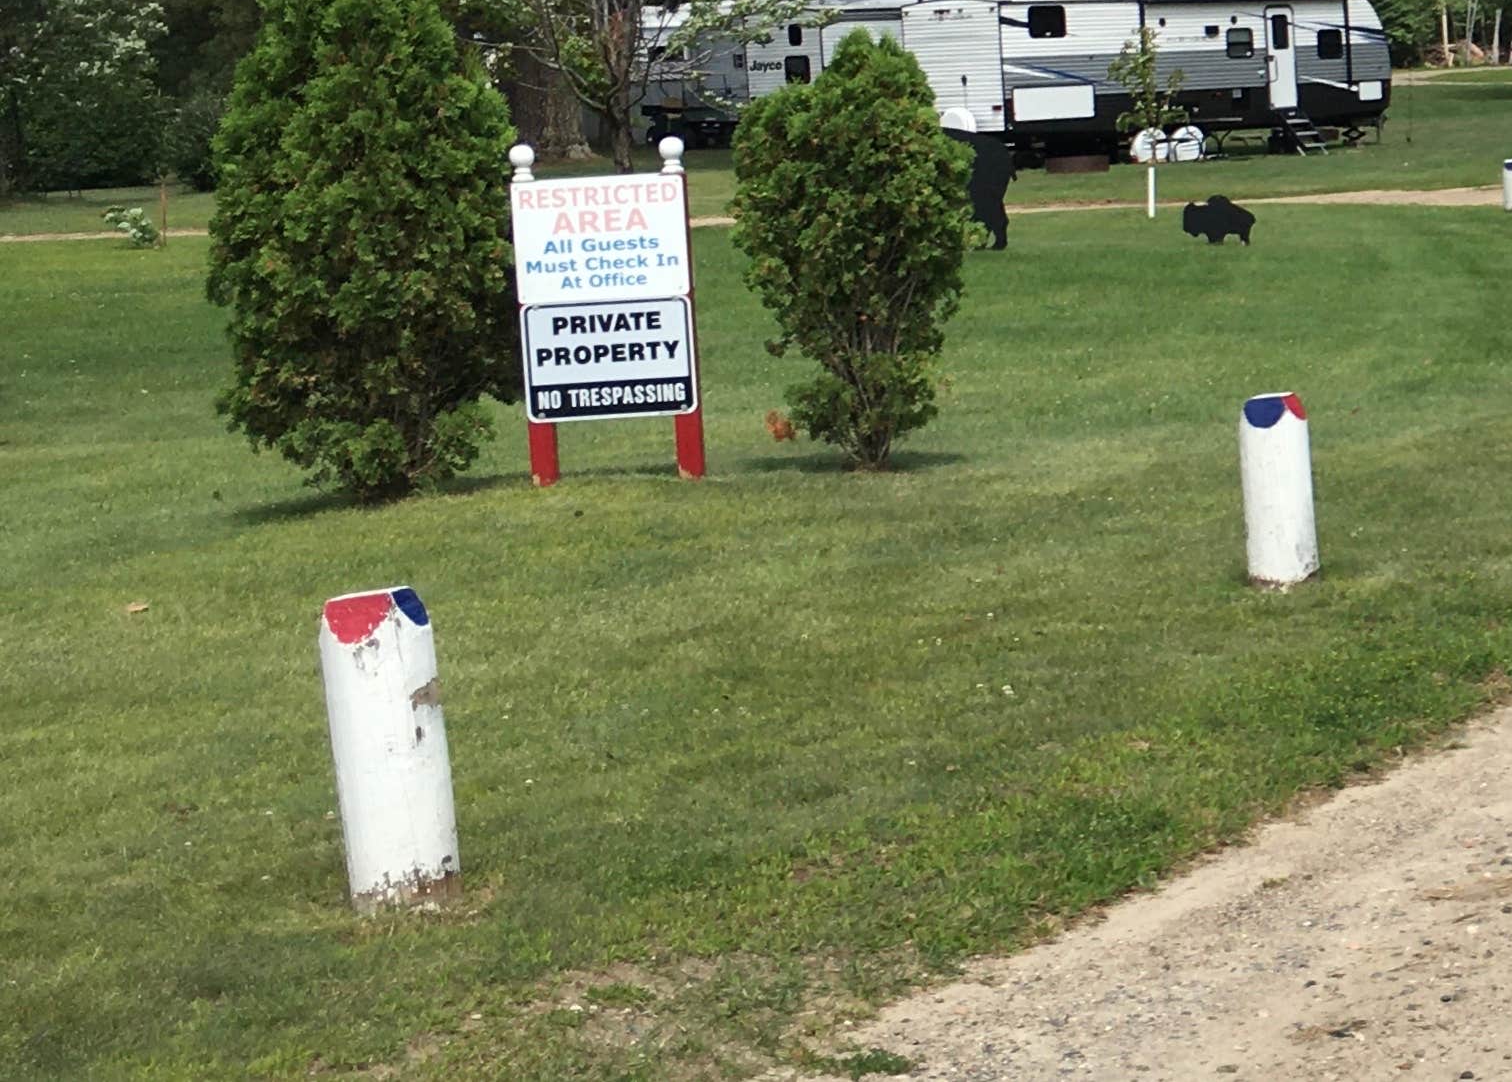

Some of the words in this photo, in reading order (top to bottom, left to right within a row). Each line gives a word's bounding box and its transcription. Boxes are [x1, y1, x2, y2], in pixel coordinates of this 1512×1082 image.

[750, 60, 782, 72] Jayco
[518, 182, 677, 210] RESTRICTED
[552, 208, 648, 235] AREA
[543, 239, 573, 255] All
[581, 235, 660, 253] Guests
[526, 258, 578, 274] Must
[585, 255, 648, 272] Check
[656, 254, 679, 268] In
[560, 275, 584, 290] At
[589, 272, 648, 289] Office
[552, 311, 661, 336] PRIVATE
[536, 340, 680, 367] PROPERTY
[537, 390, 562, 411] NO
[568, 382, 686, 408] TRESPASSING
